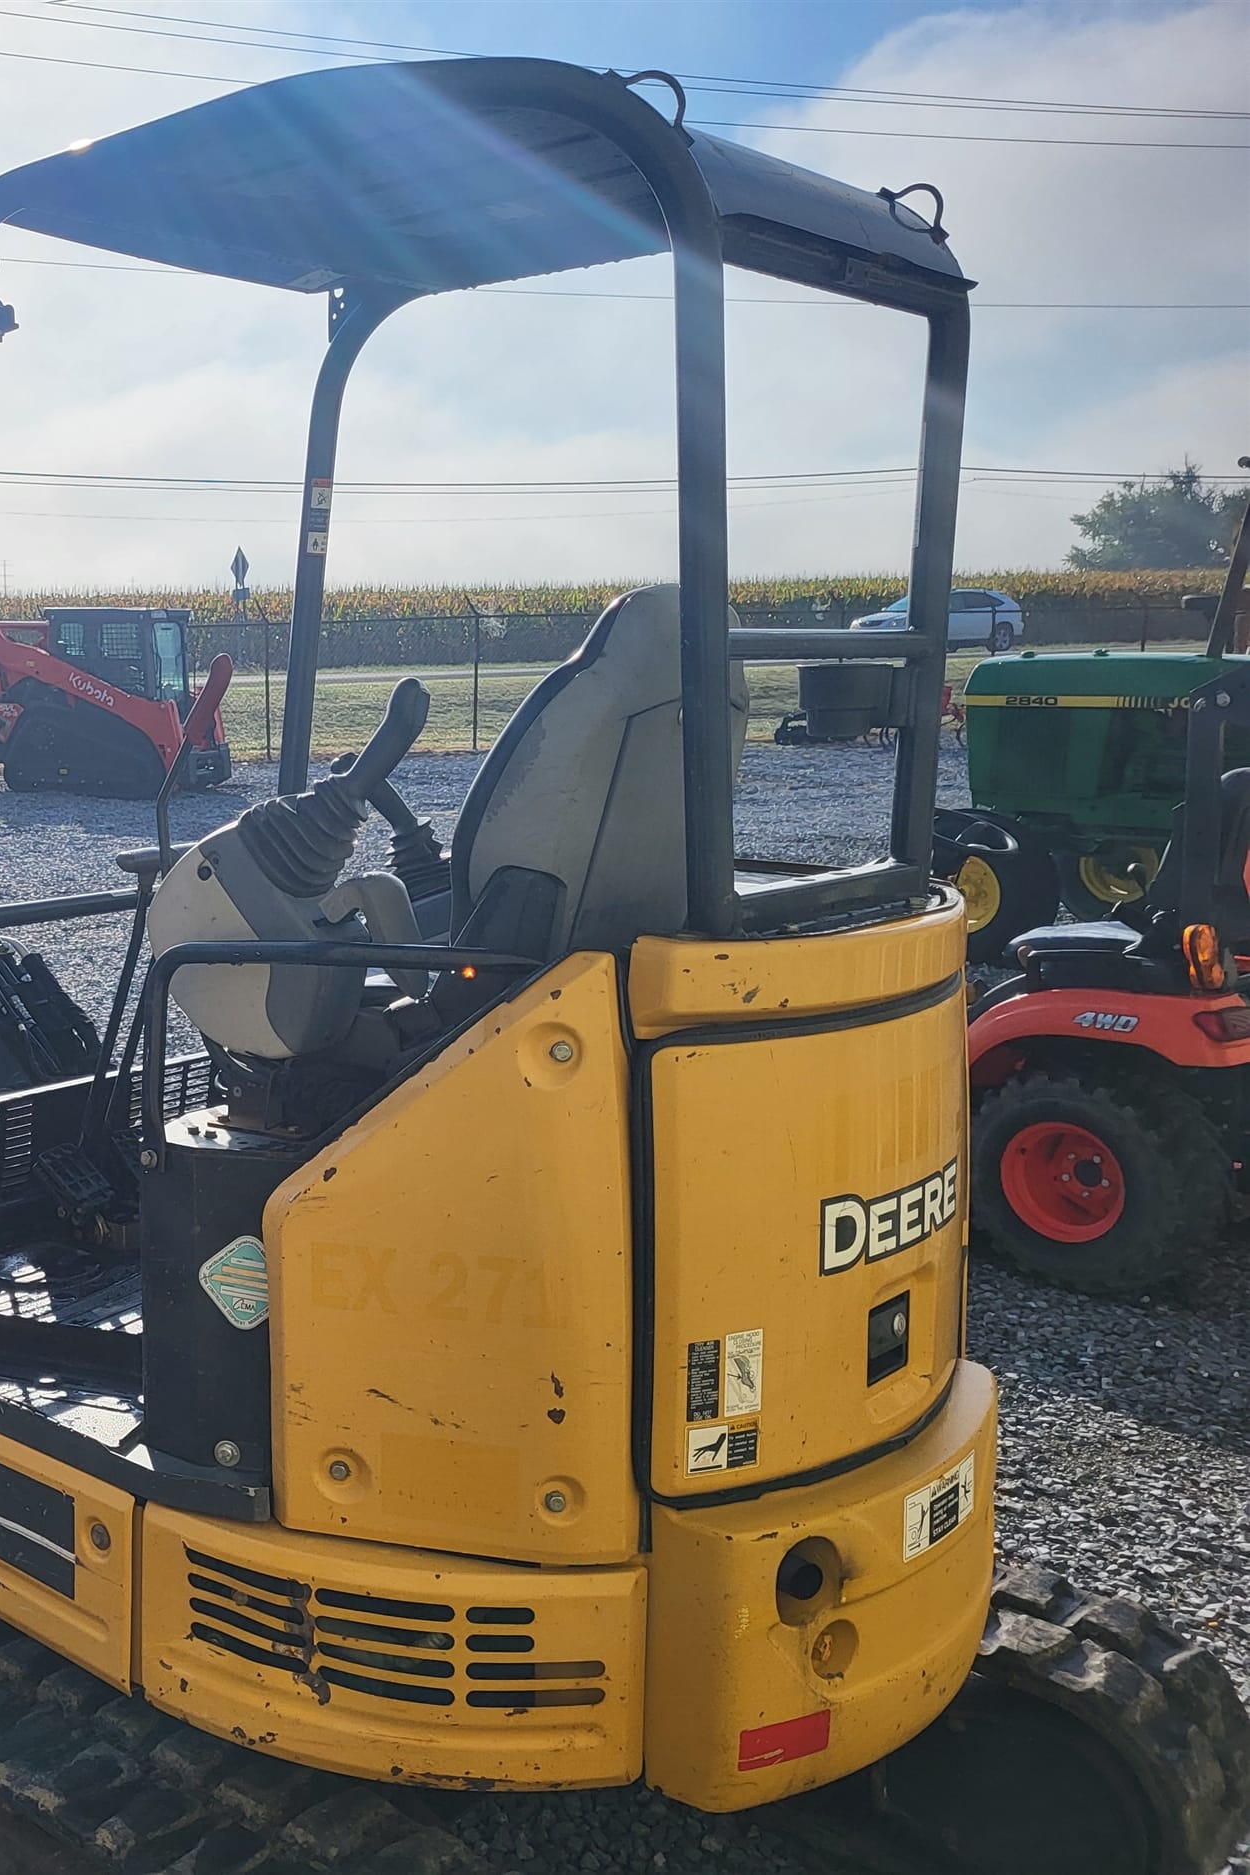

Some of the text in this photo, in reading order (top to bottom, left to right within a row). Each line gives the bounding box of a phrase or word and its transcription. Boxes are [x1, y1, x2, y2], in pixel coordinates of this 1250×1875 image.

[68, 672, 115, 707] Kubota
[1005, 695, 1058, 706] 2840
[1072, 1011, 1139, 1032] 4WD
[822, 1161, 957, 1272] DEERE
[310, 1241, 567, 1330] EX 271
[936, 1470, 959, 1491] WARNING
